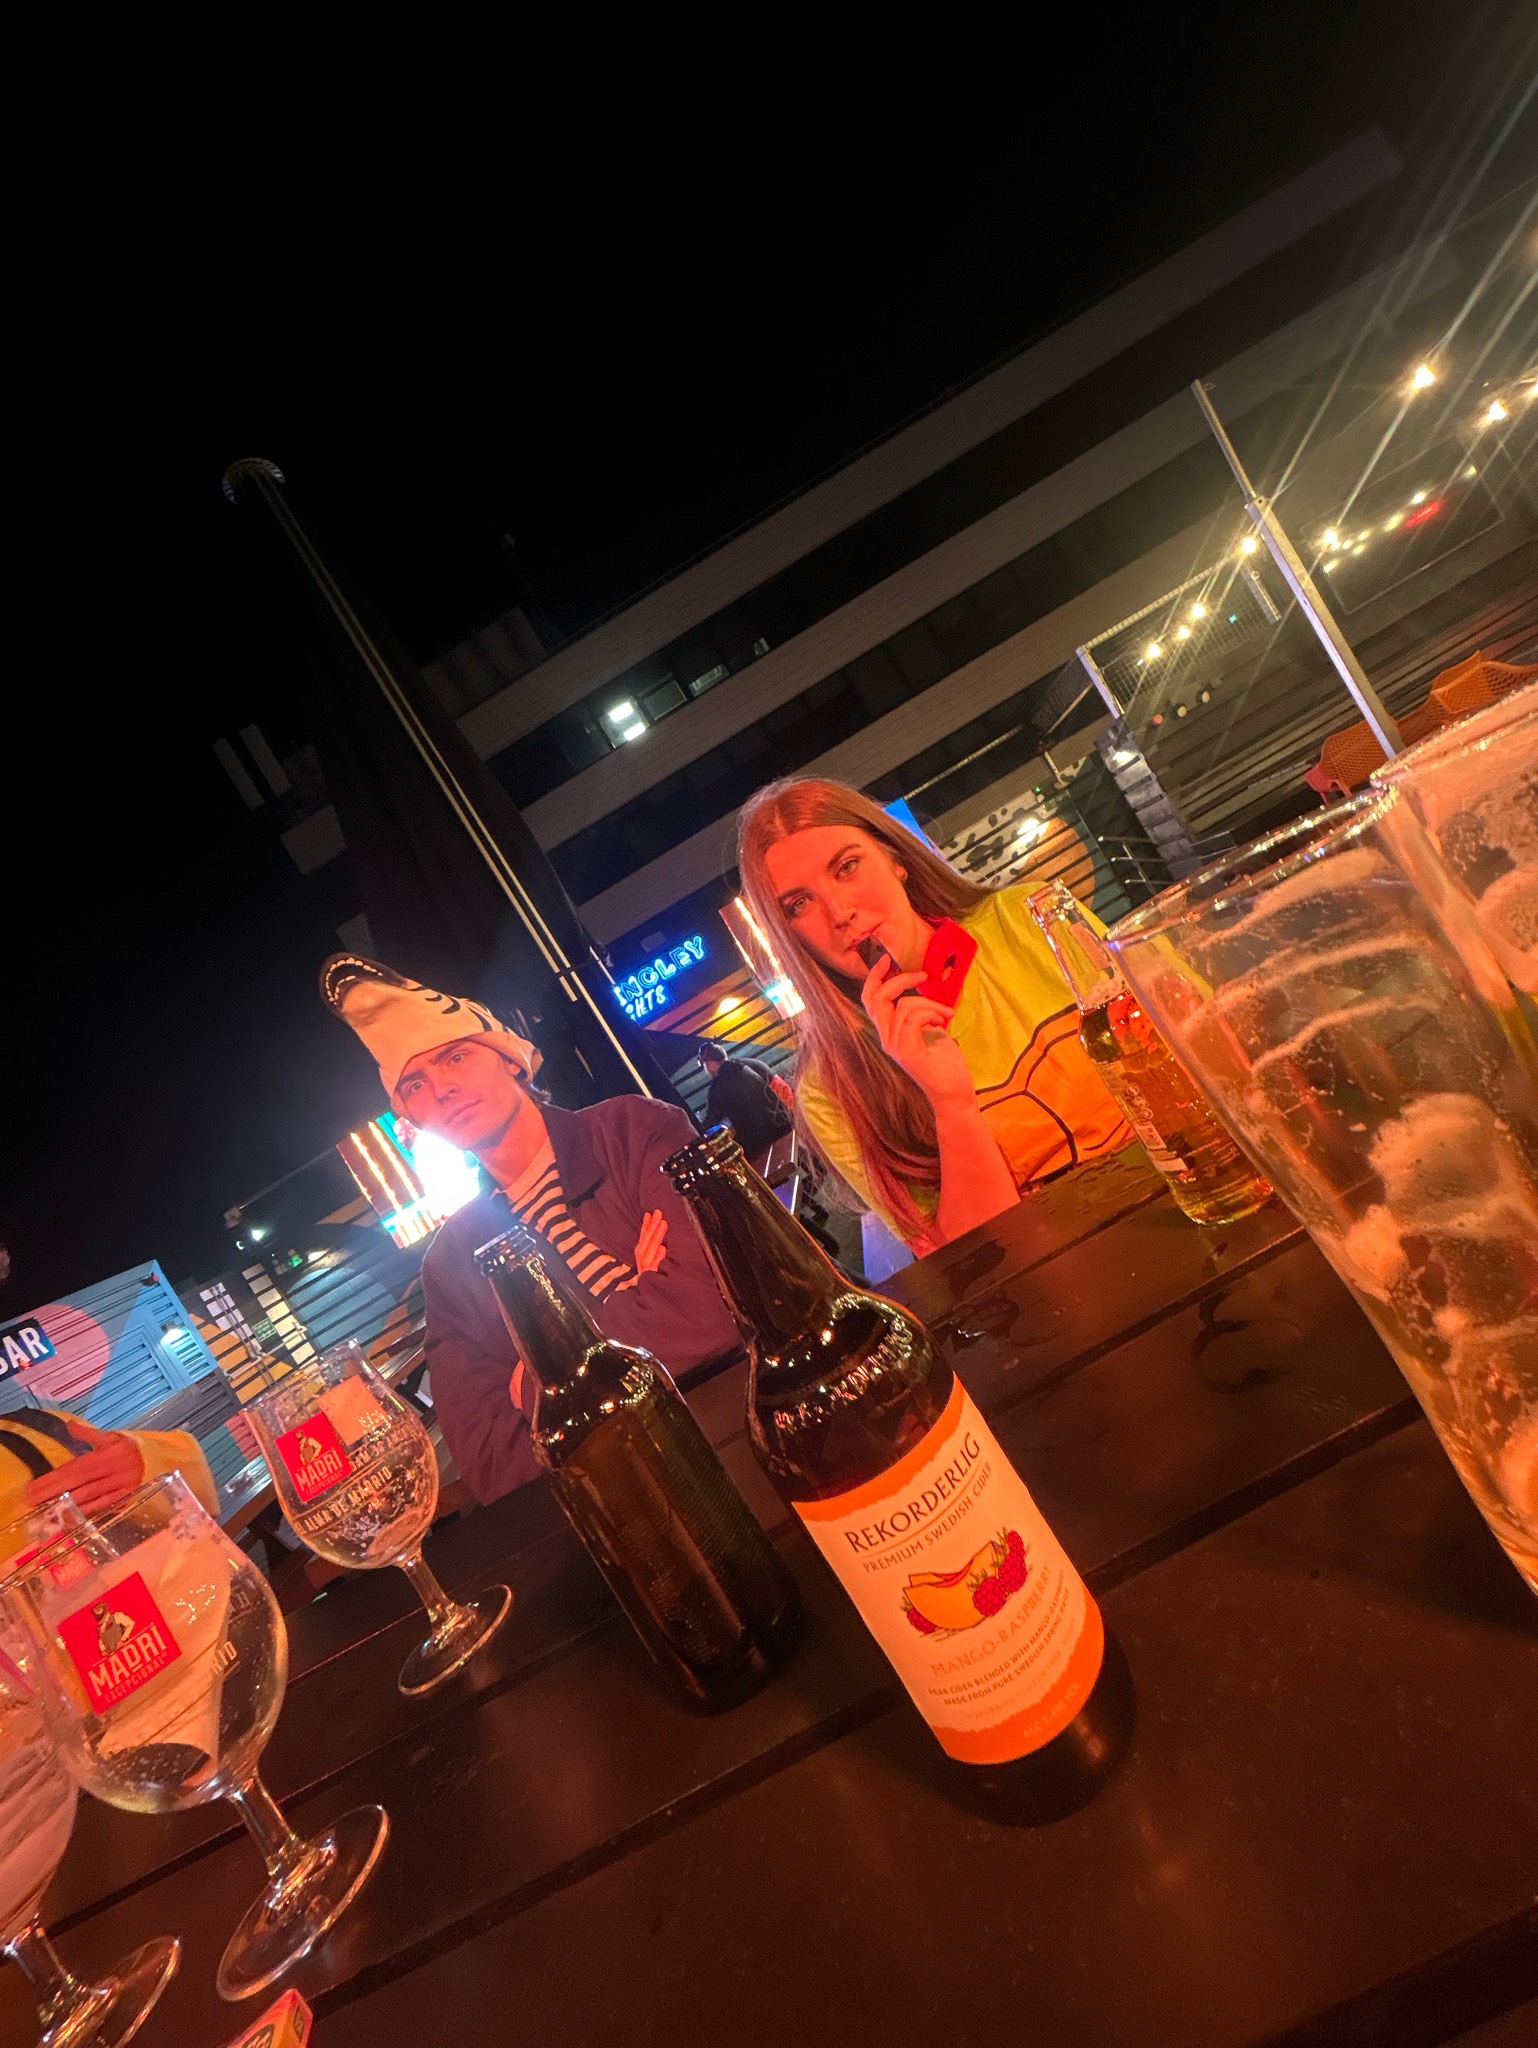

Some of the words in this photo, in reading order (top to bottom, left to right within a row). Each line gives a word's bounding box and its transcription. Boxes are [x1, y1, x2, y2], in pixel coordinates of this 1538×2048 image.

[303, 1510, 332, 1531] ALMA
[330, 1502, 349, 1517] DE
[348, 1465, 393, 1507] MADRID
[844, 1432, 980, 1553] REKORDERLIG
[863, 1541, 924, 1573] PREMIUM
[924, 1495, 973, 1546] SWEDISH
[972, 1462, 992, 1497] CIDER
[930, 1565, 1051, 1677] MANGO-RASPBERRY
[950, 1682, 973, 1696] CIDER
[973, 1660, 1011, 1686] BLENDED
[1010, 1645, 1030, 1665] WITH
[968, 1686, 993, 1703] FROM
[993, 1675, 1015, 1693] PURE
[1014, 1643, 1046, 1677] SWEDISH
